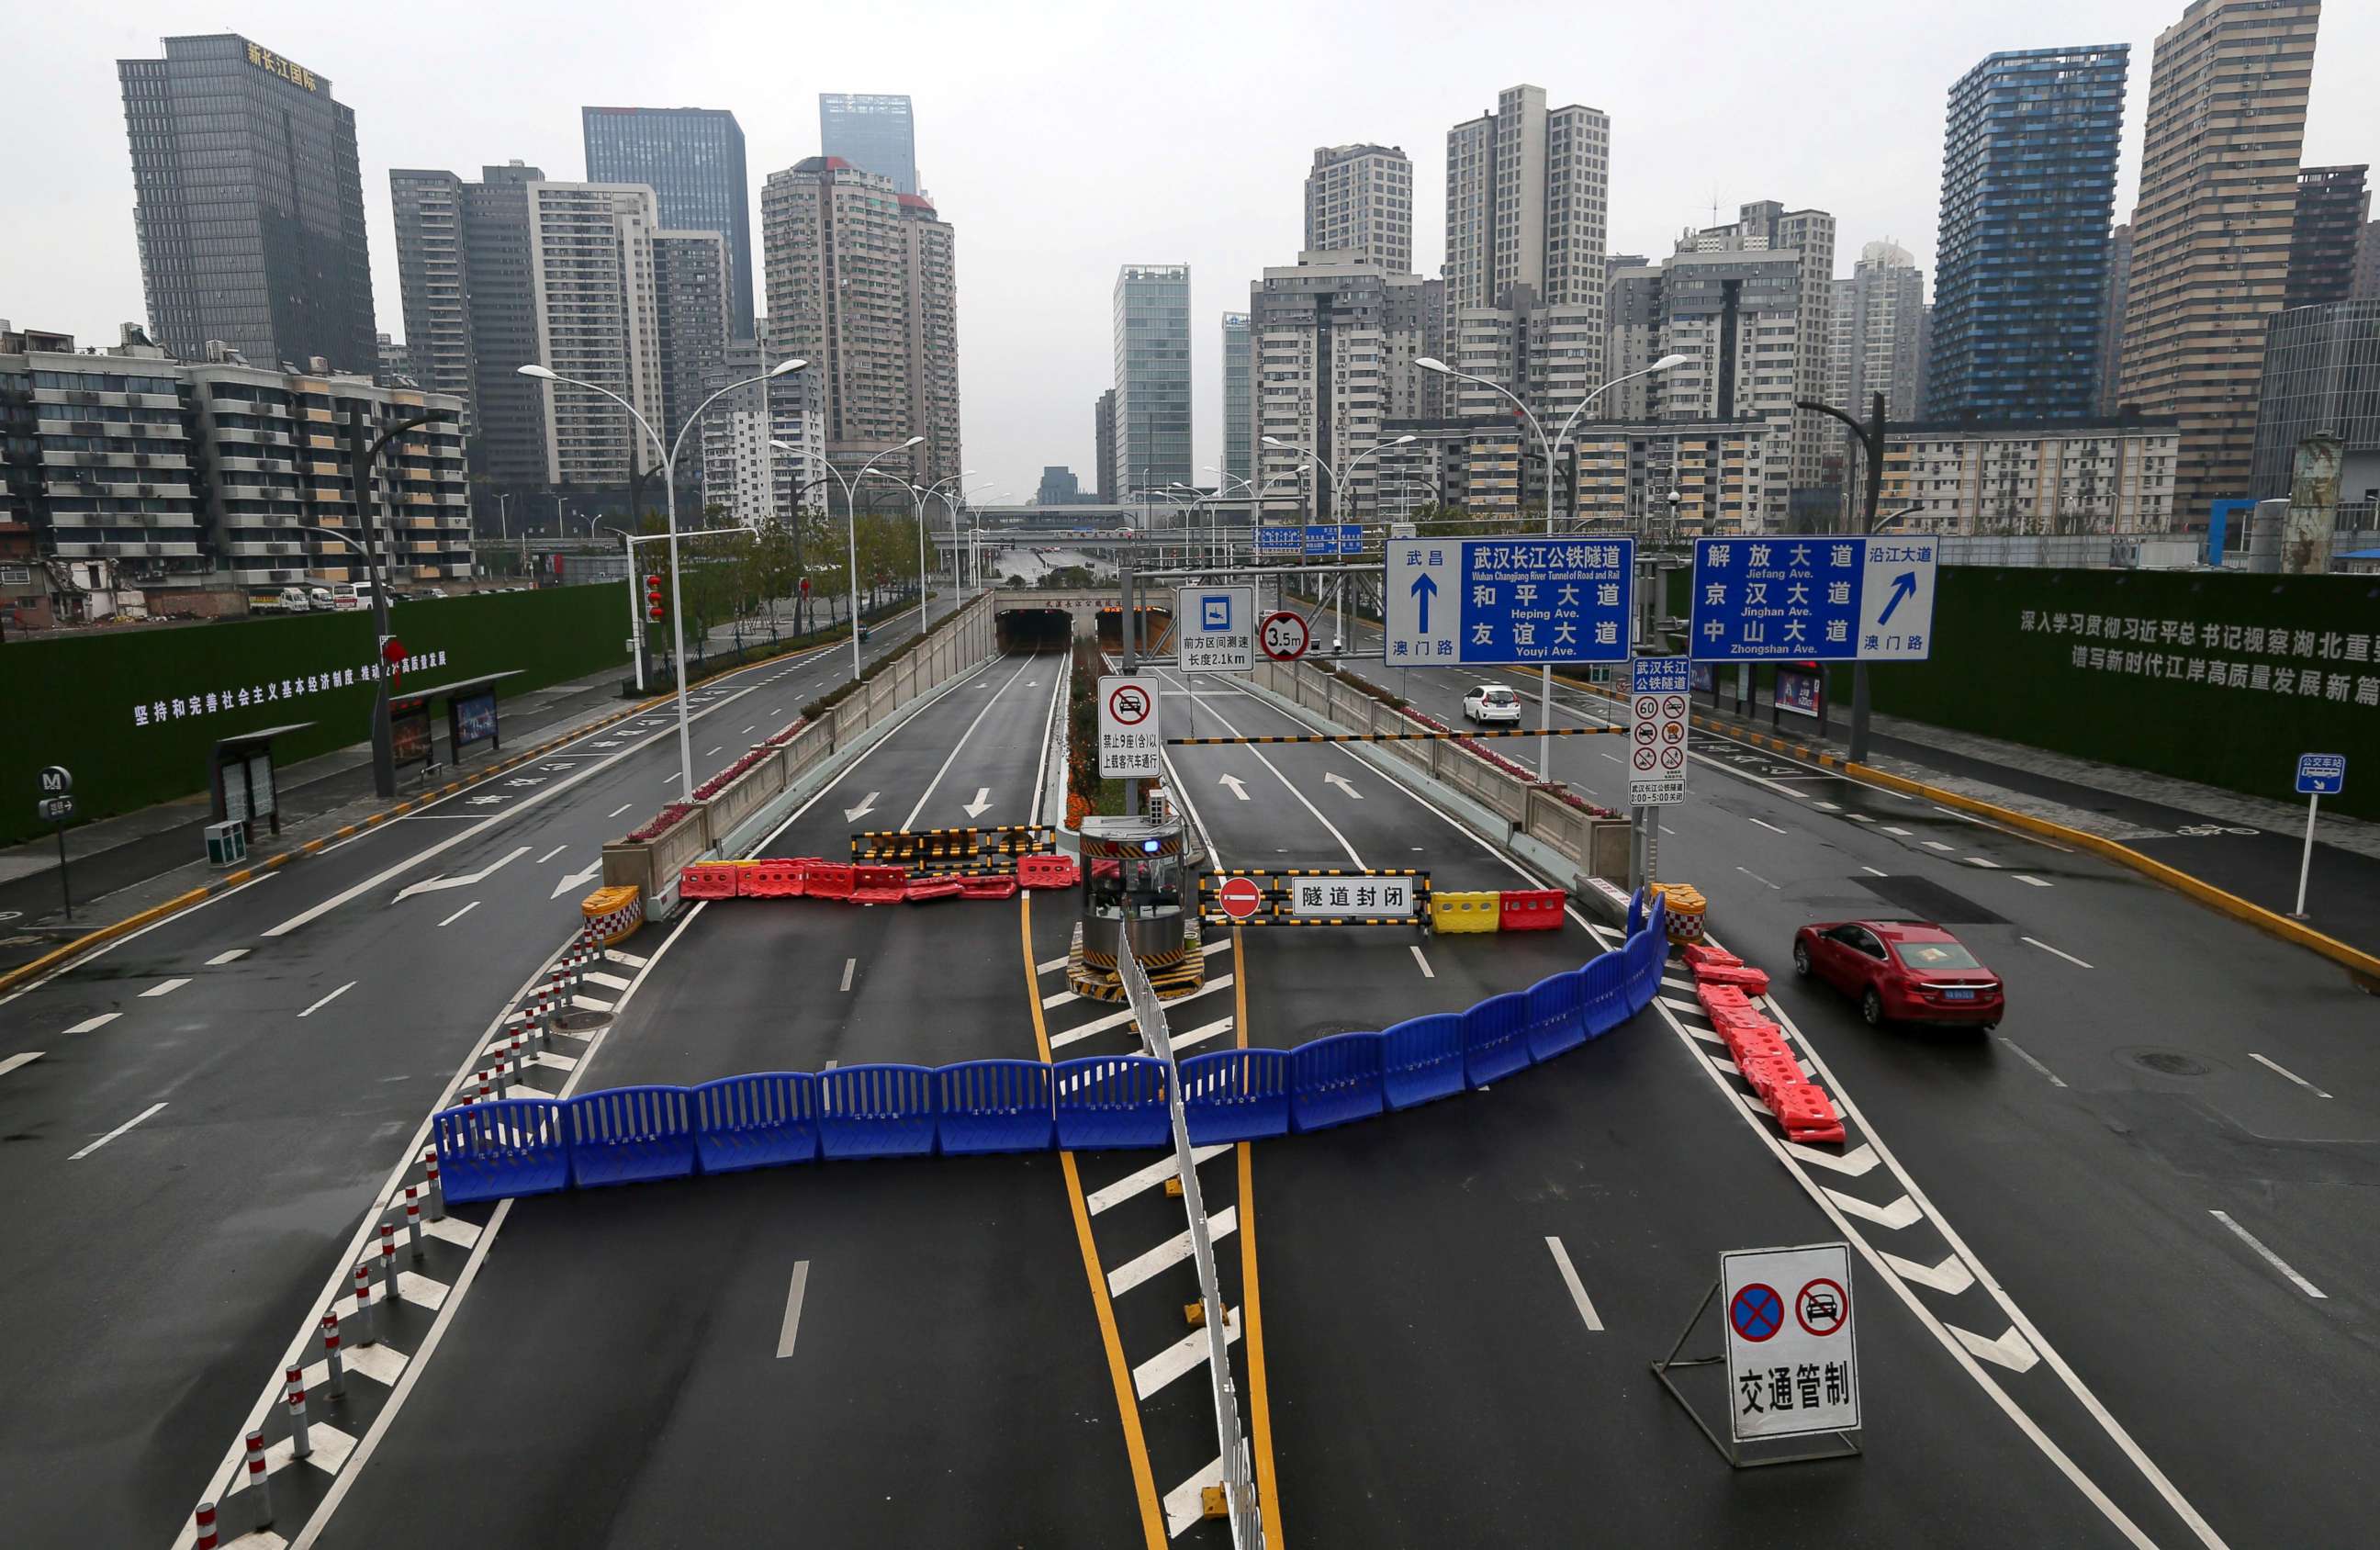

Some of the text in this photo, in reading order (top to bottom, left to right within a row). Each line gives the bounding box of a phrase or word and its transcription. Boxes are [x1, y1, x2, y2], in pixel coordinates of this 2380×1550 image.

[248, 42, 317, 92] 新长江国际
[1406, 549, 1444, 567] 武昌
[1473, 545, 1621, 570] 武汉长江公铁隧道
[1706, 544, 1853, 567] 解放大道
[1869, 546, 1933, 563] 沿江大道
[1472, 570, 1621, 583] Wuhan Changjiang River Tunnel of Road and Rail
[1746, 568, 1814, 580] Jiefang Ave.
[1472, 583, 1620, 609] 和平大道
[1704, 581, 1851, 606] 京汉大道
[1511, 609, 1579, 620] Heping Ave.
[1741, 606, 1813, 618] Jinghan Ave.
[1268, 627, 1301, 646] 3.5m
[1472, 621, 1618, 646] 友谊大道
[1703, 618, 1848, 643] 中山大道
[1183, 635, 1250, 649] 前方区间测速
[1392, 640, 1454, 657] 澳门路
[1730, 644, 1818, 656] Zhongshan Ave.
[1864, 635, 1924, 651] 澳门路
[1516, 646, 1577, 657] Youyi Ave.
[1188, 653, 1245, 667] 长度2.1km
[1636, 660, 1688, 676] 武汉长江
[1635, 676, 1687, 691] 公铁隧道
[2071, 645, 2380, 706] 谱写新时代江岸高质量发展新篇
[134, 668, 354, 726] 坚持和完善社会主义基本经济制度
[1640, 702, 1655, 714] 60
[1103, 734, 1157, 749] 禁止9座(含)以
[1103, 754, 1157, 769] 上载客汽车通行
[2302, 758, 2342, 768] 公交车站
[42, 773, 62, 790] M
[1631, 783, 1683, 793] 武汉长江公铁隧道
[1302, 886, 1404, 907] 隧道封闭
[1739, 1360, 1850, 1416] 交通管制
